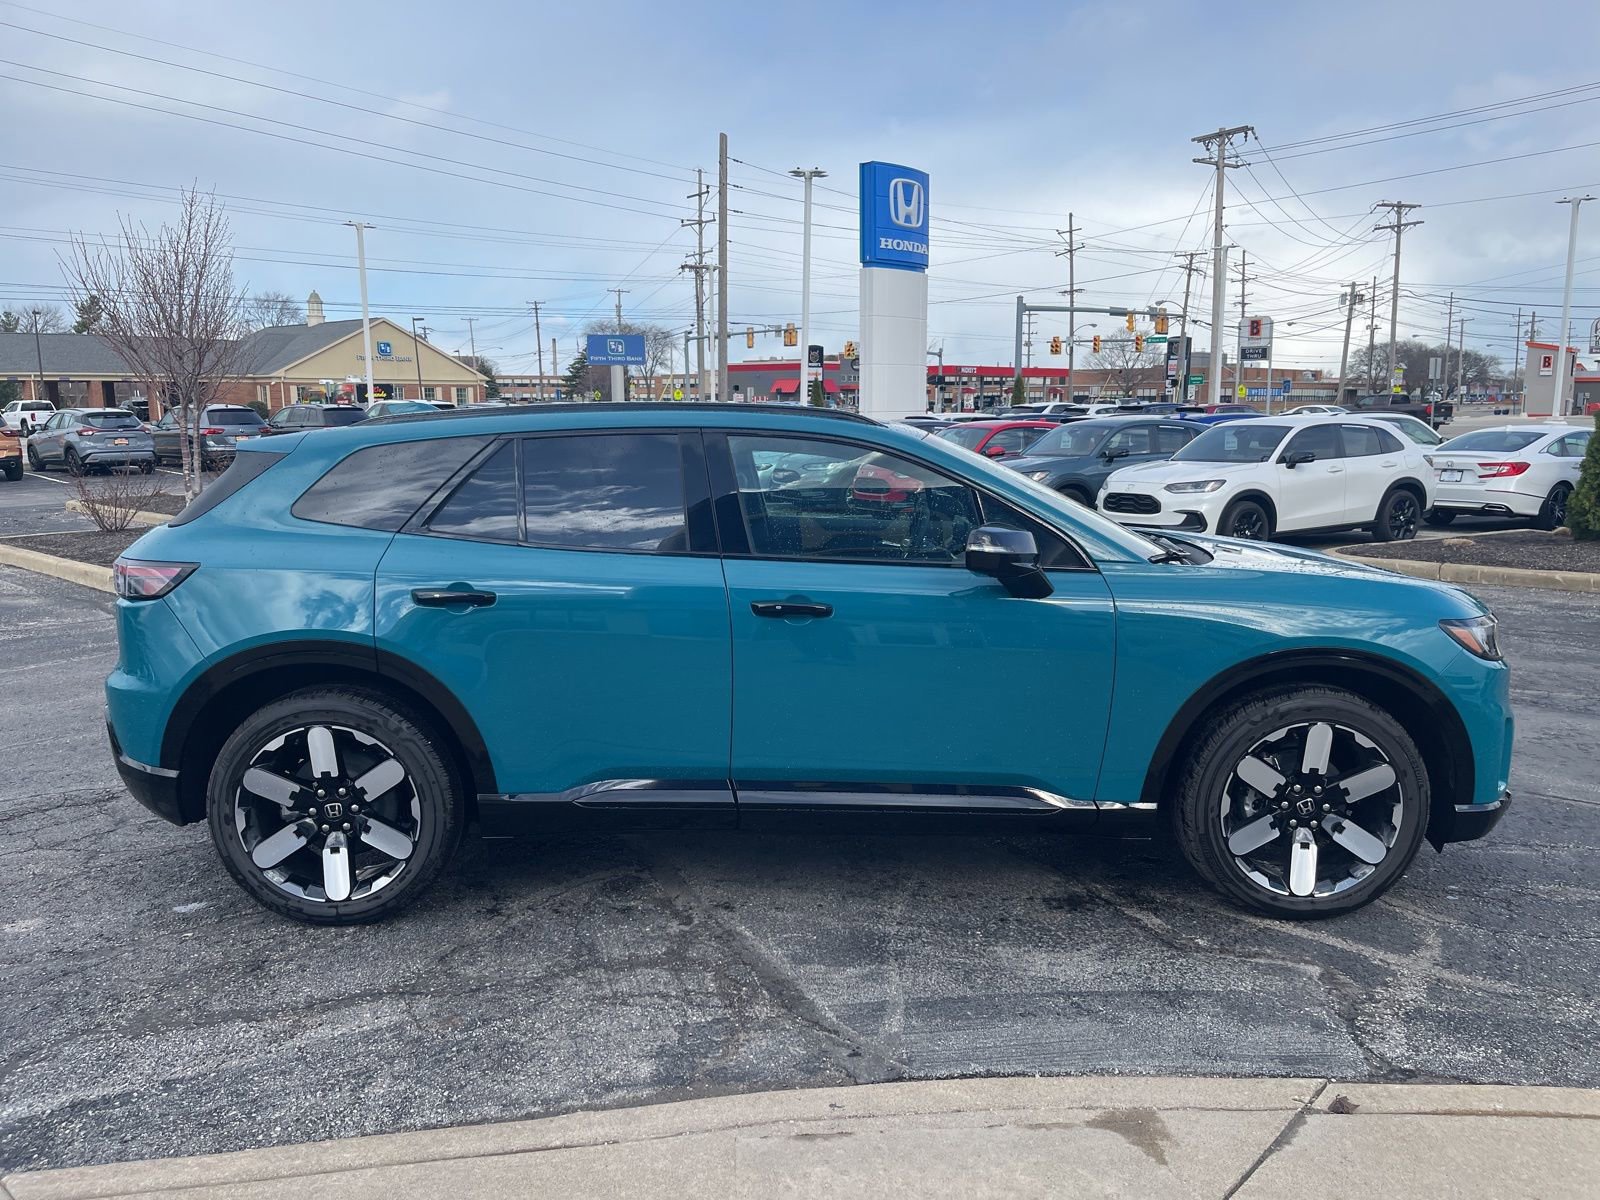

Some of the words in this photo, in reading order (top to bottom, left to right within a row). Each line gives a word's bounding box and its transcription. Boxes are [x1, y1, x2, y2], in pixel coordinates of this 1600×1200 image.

[880, 237, 928, 254] HONDA
[1250, 320, 1261, 336] B
[1543, 356, 1552, 368] B
